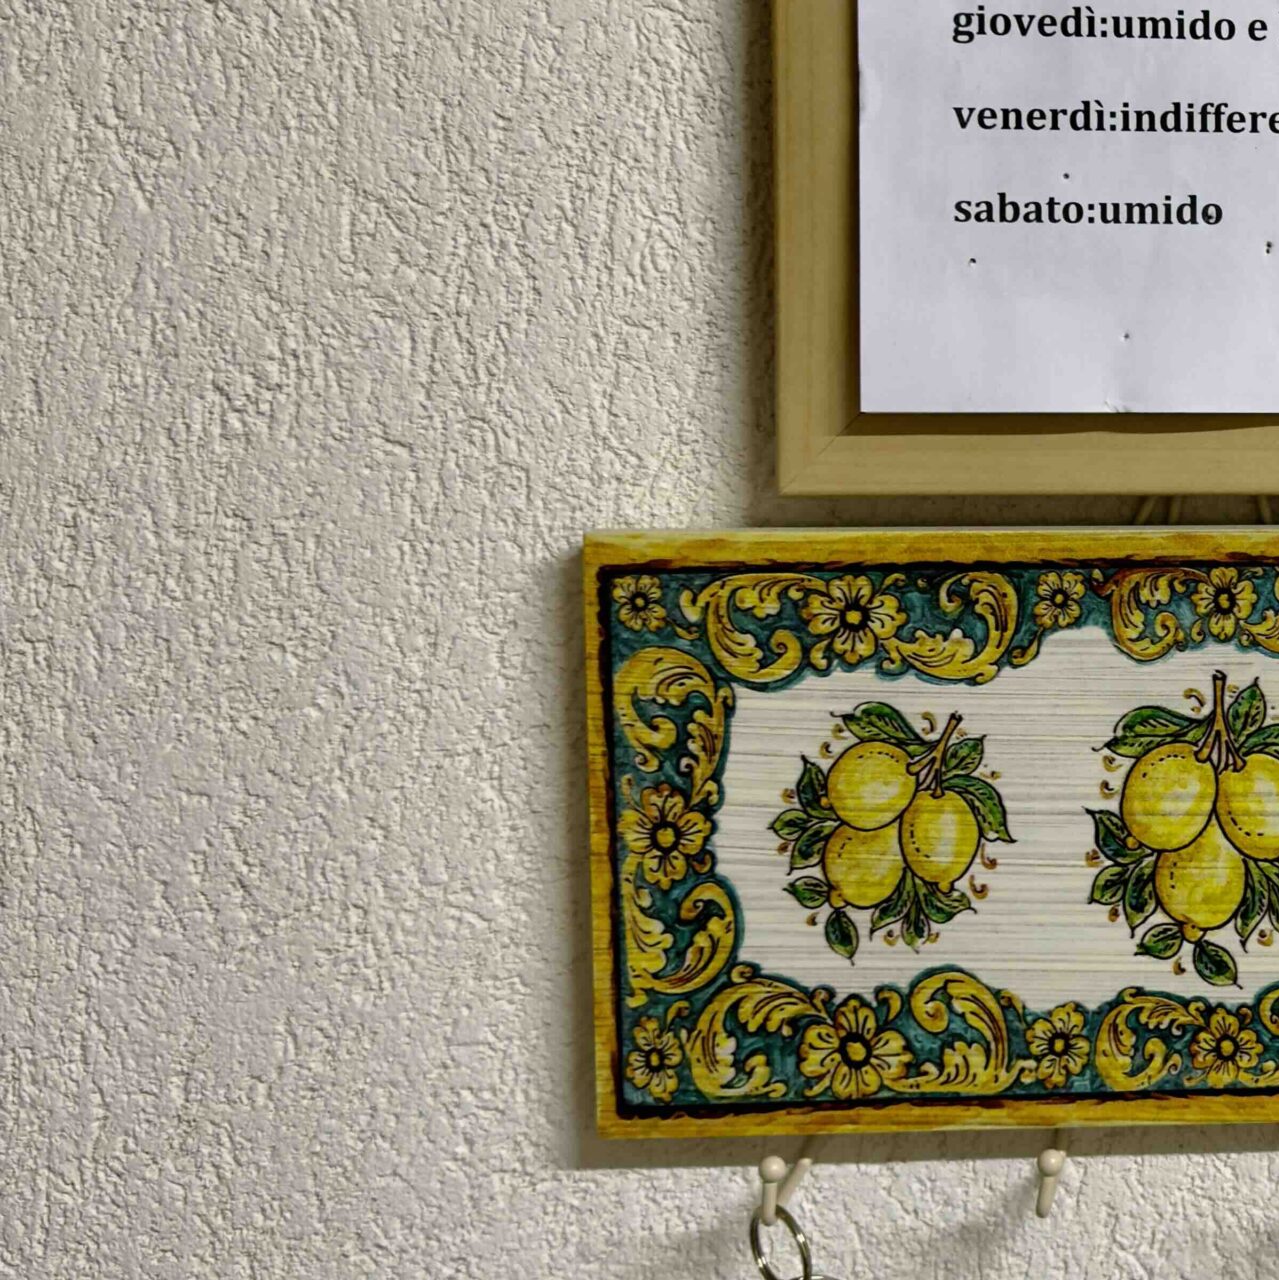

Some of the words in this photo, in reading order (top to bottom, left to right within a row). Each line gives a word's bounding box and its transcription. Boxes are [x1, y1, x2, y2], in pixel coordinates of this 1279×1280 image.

[952, 5, 1236, 44] giovedì:umido
[1247, 20, 1268, 42] e
[954, 193, 1223, 226] sabato:umido
